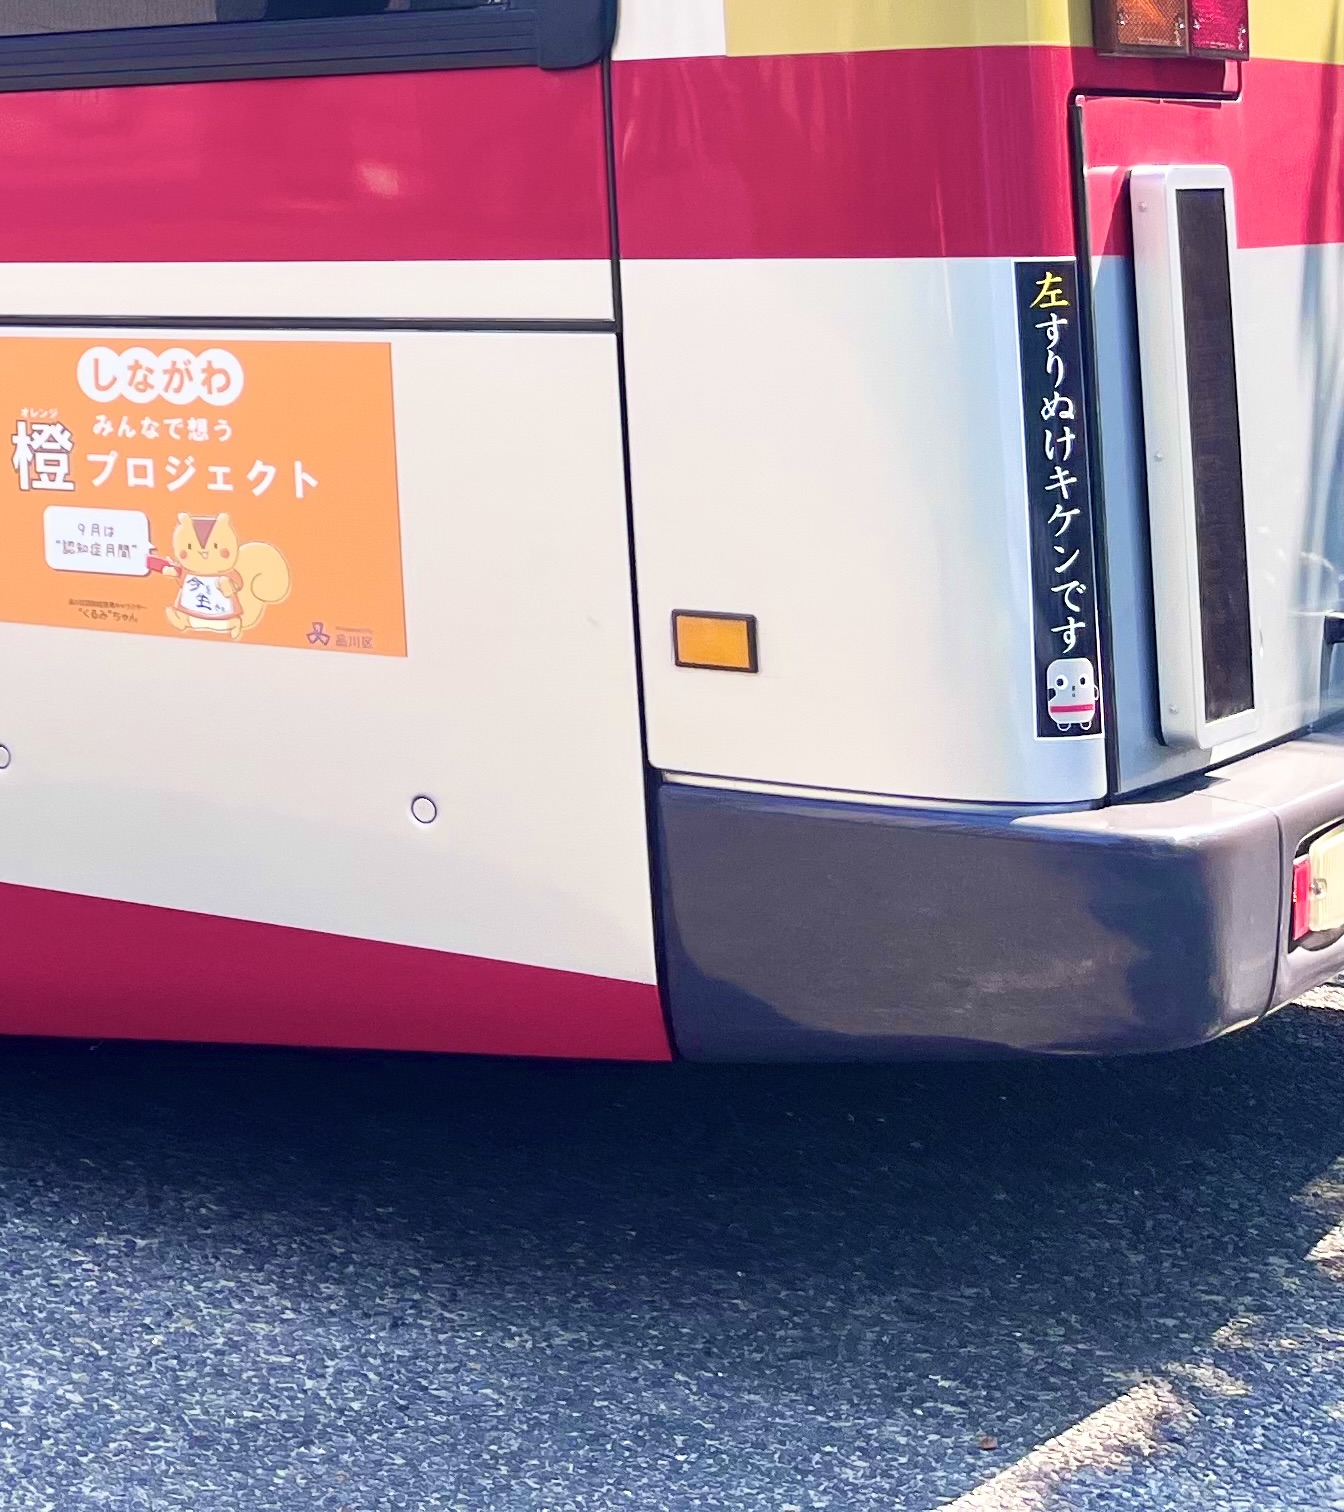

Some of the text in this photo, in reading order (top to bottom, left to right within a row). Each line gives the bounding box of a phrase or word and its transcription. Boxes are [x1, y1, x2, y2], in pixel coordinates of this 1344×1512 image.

[92, 357, 232, 395] しながわ
[92, 414, 233, 442] みんなで想う
[86, 450, 319, 499] プロジェクト
[1029, 271, 1089, 656] 左すりぬけキケンです
